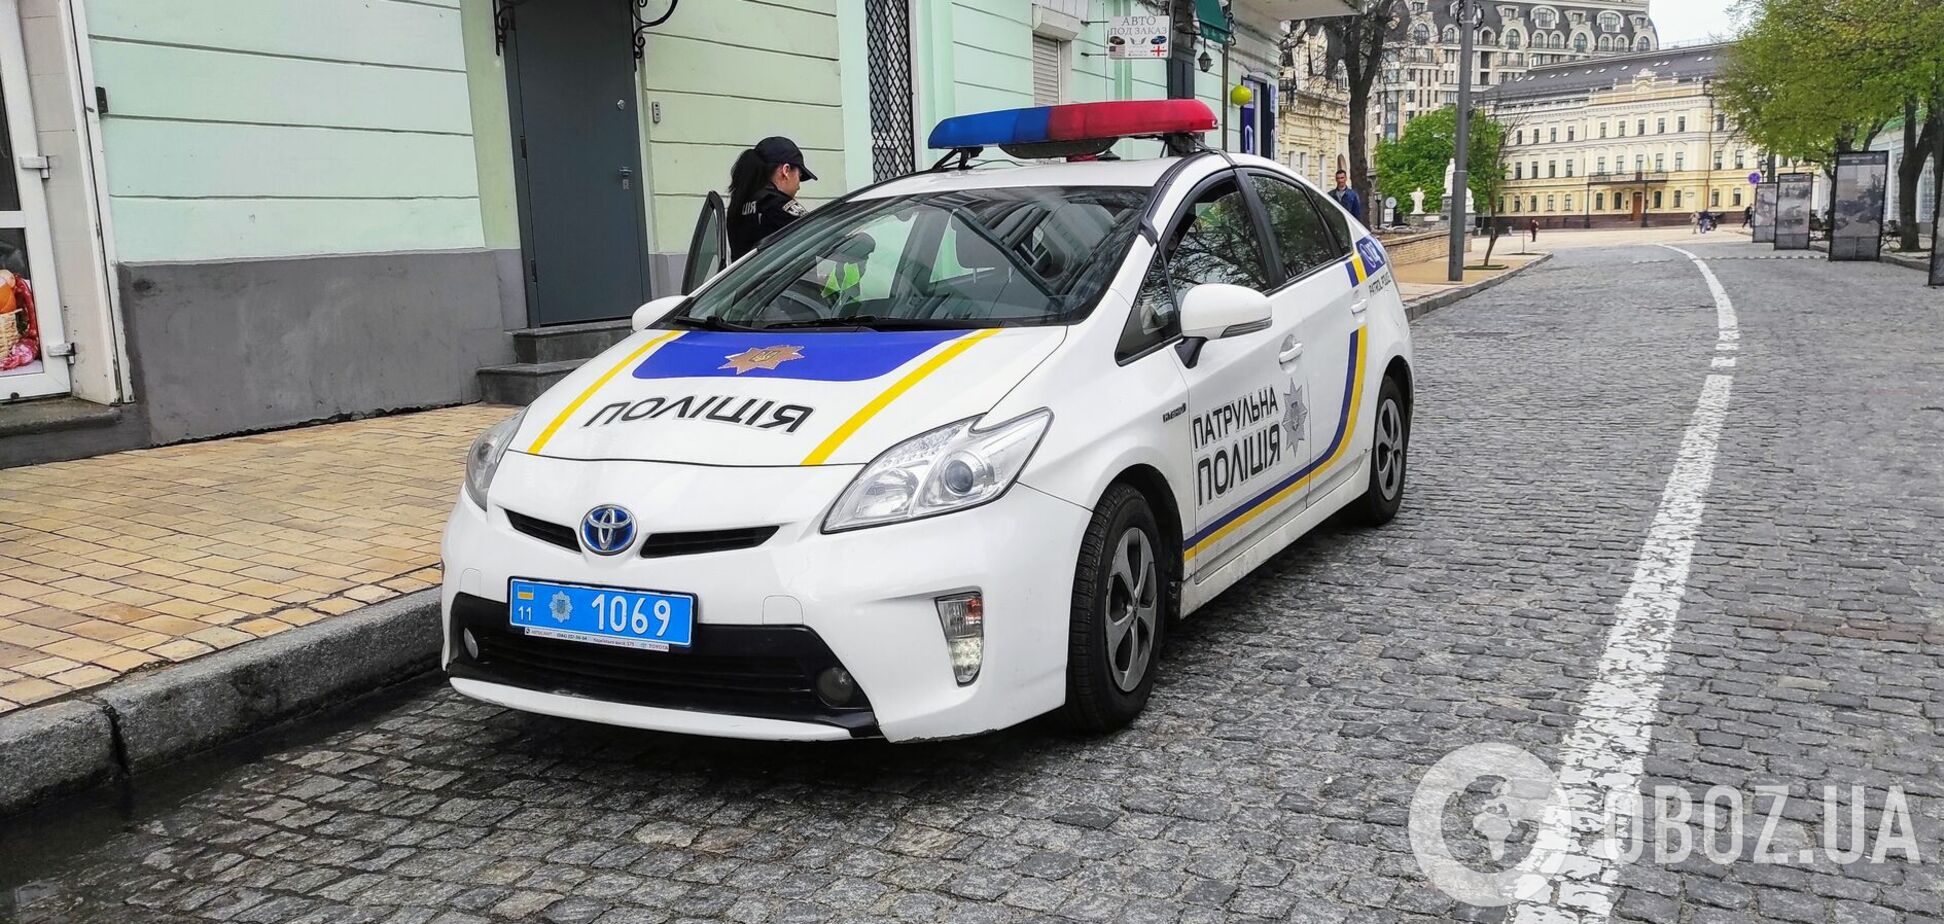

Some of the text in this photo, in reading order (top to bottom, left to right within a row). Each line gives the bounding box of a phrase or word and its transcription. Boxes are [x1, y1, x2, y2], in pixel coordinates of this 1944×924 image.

[1110, 27, 1167, 36] ПОД ЗАКАЗ
[1122, 16, 1156, 26] АВТО
[583, 395, 814, 433] ПОЛІЦІЯ
[1193, 386, 1279, 449] ПАТРУЛЬНА
[1198, 423, 1281, 506] ПОЛІЦІЯ
[518, 605, 533, 621] 11
[591, 593, 671, 637] 1069
